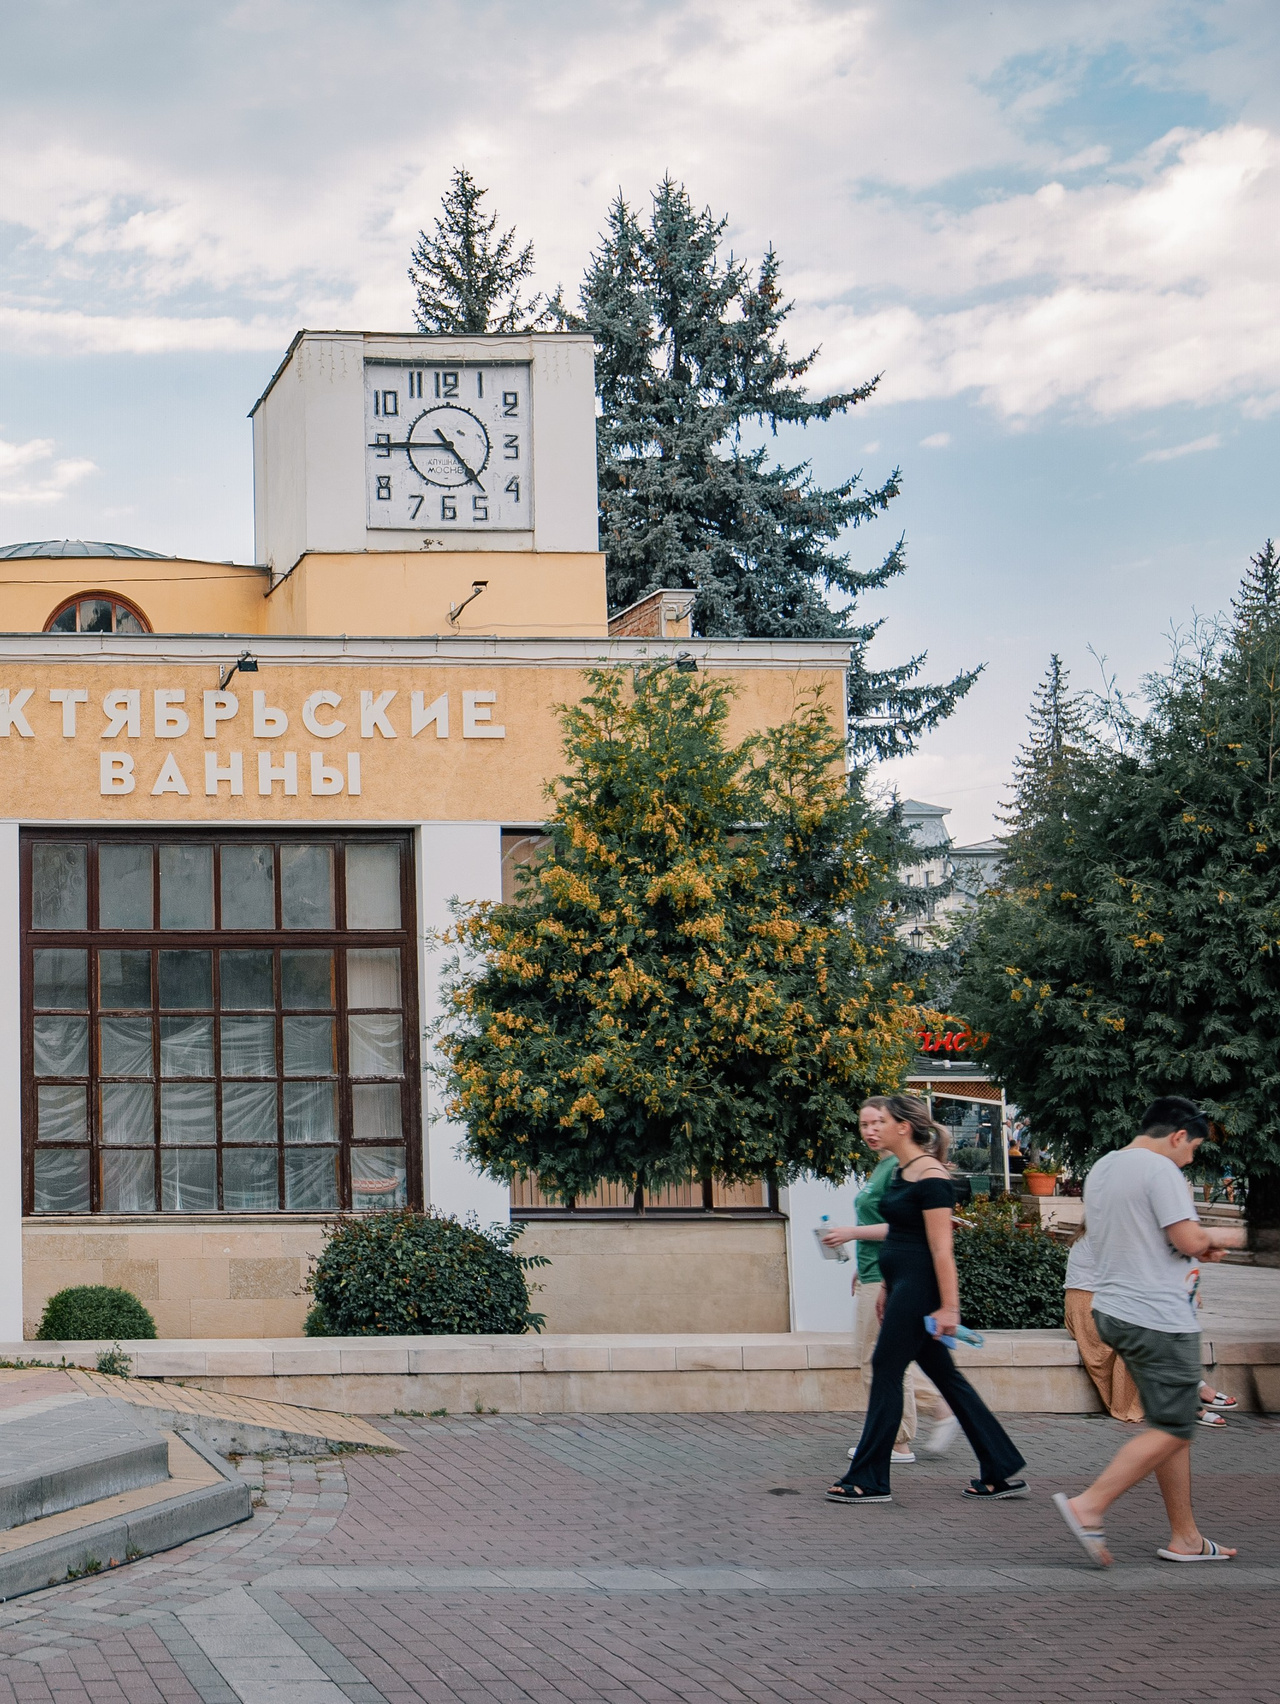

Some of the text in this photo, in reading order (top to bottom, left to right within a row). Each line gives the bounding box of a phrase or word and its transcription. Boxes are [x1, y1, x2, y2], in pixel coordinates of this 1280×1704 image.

[409, 371, 423, 398] 11
[434, 371, 459, 398] 12
[477, 371, 484, 398] 1
[374, 390, 398, 417] 10
[503, 391, 519, 417] 2
[504, 434, 519, 460] 3
[376, 475, 391, 500] 8
[504, 476, 520, 502] 4
[409, 495, 424, 520] 7
[441, 495, 457, 520] 6
[473, 495, 488, 521] 5
[99, 751, 361, 796] ВАННЫ
